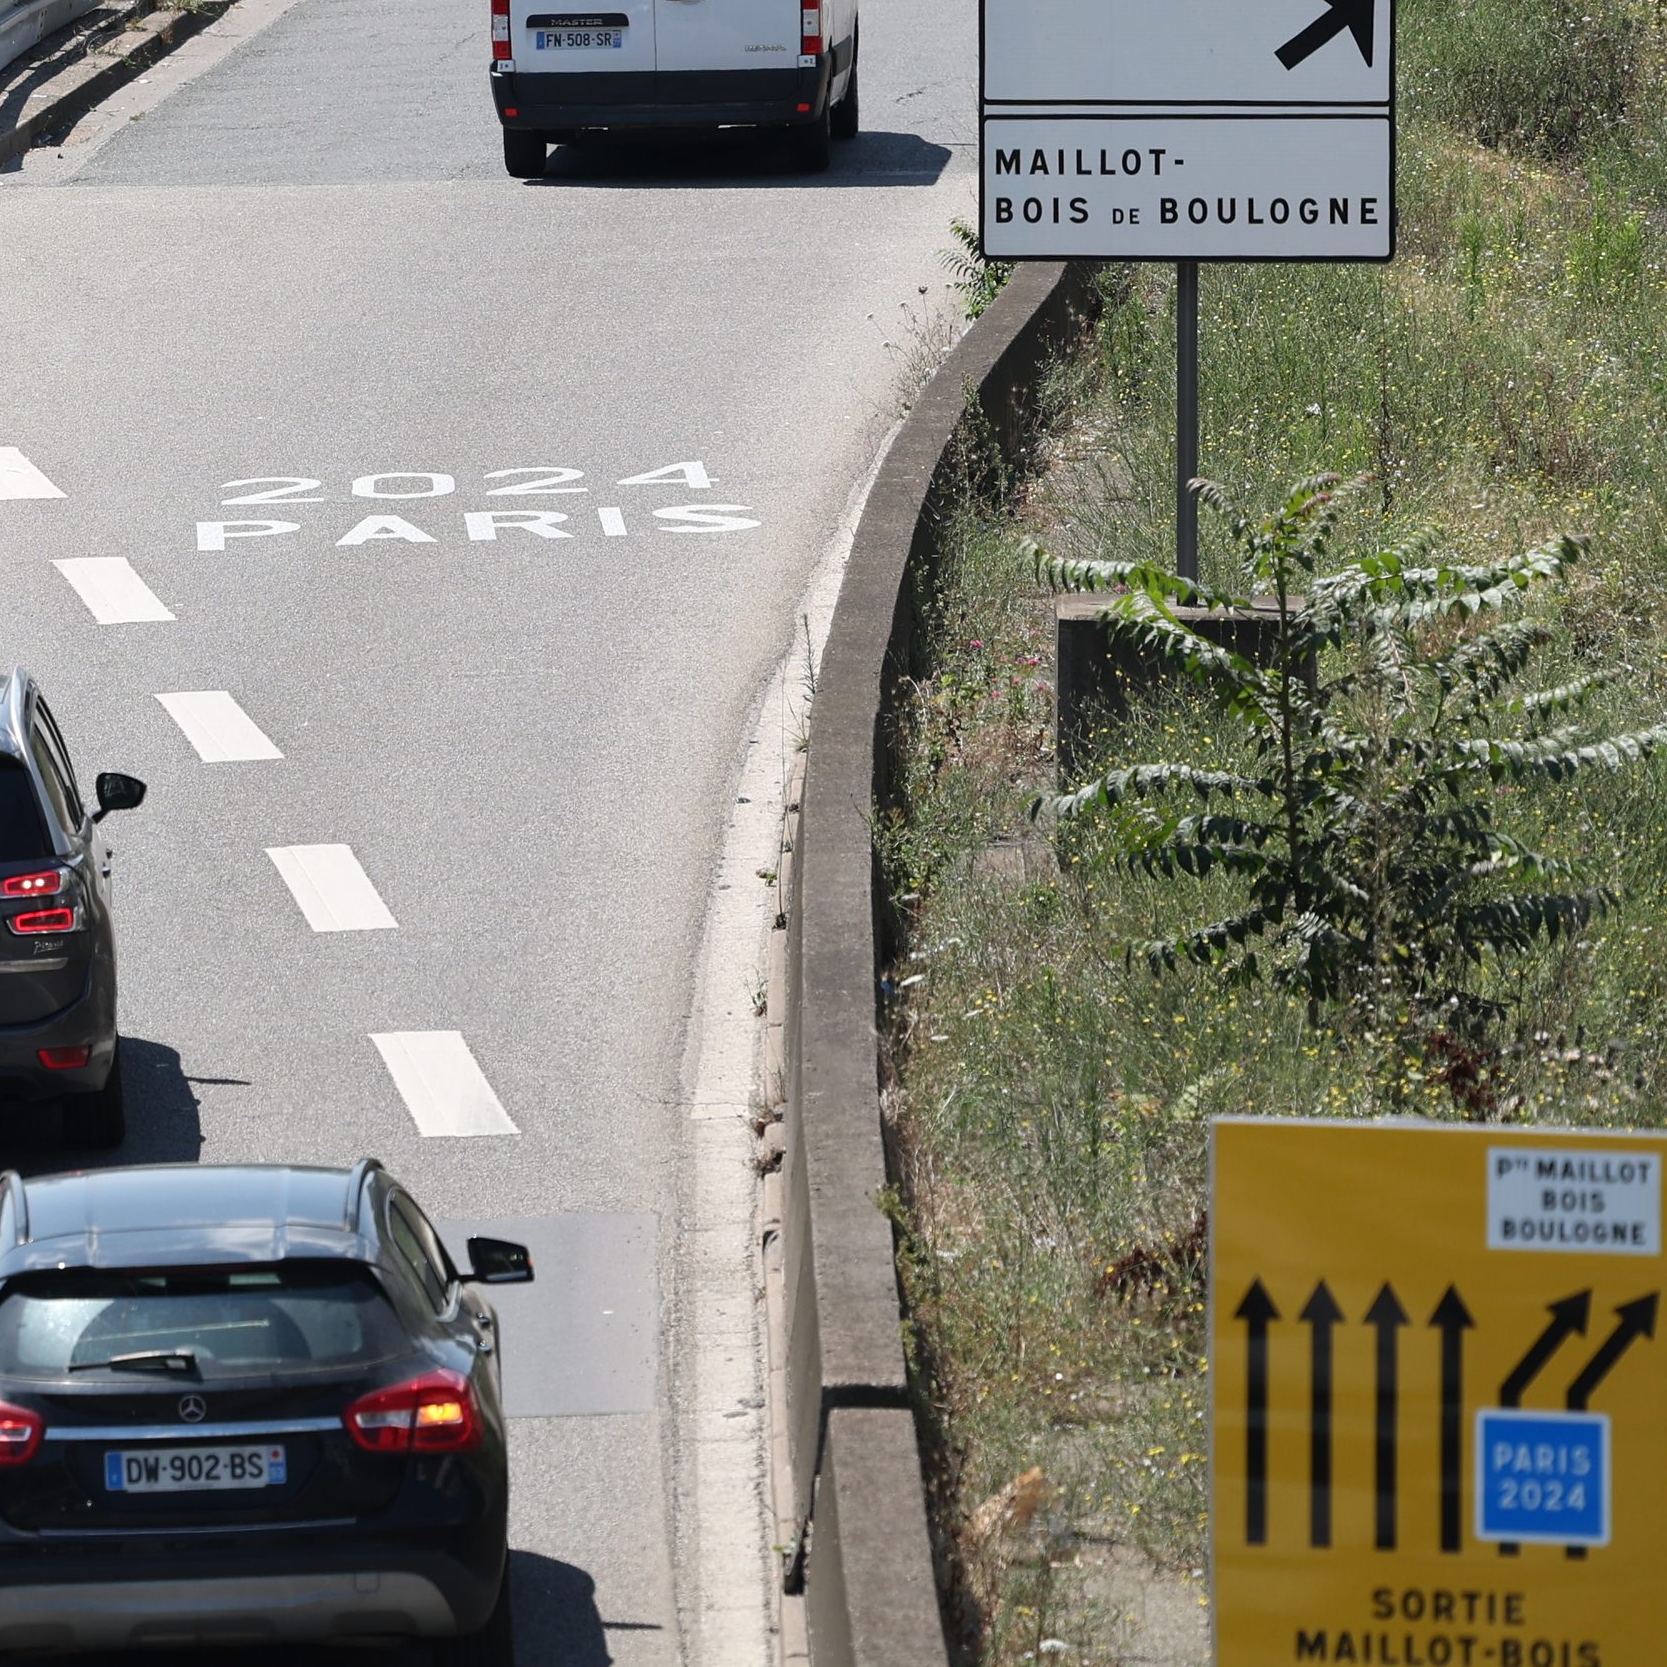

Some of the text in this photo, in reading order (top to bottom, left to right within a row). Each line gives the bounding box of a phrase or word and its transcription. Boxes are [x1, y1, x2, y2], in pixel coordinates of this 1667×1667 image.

[551, 18, 603, 26] MASTER
[546, 31, 613, 48] FN-508-SR
[994, 148, 1185, 176] MAILLOT-
[995, 196, 1379, 226] BOIS DE BOULOGNE
[219, 460, 720, 506] 2024
[196, 503, 763, 552] PARIS
[1535, 1158, 1653, 1184] MAILLOT
[1541, 1189, 1605, 1213] BOIS
[1502, 1218, 1648, 1246] BOULOGNE
[125, 1452, 264, 1485] DW-902-BS
[1493, 1441, 1592, 1477] PARIS
[1497, 1477, 1587, 1512] 2024
[1371, 1586, 1527, 1626] SORTIE
[1293, 1629, 1603, 1667] MAILLOT-BOIS
